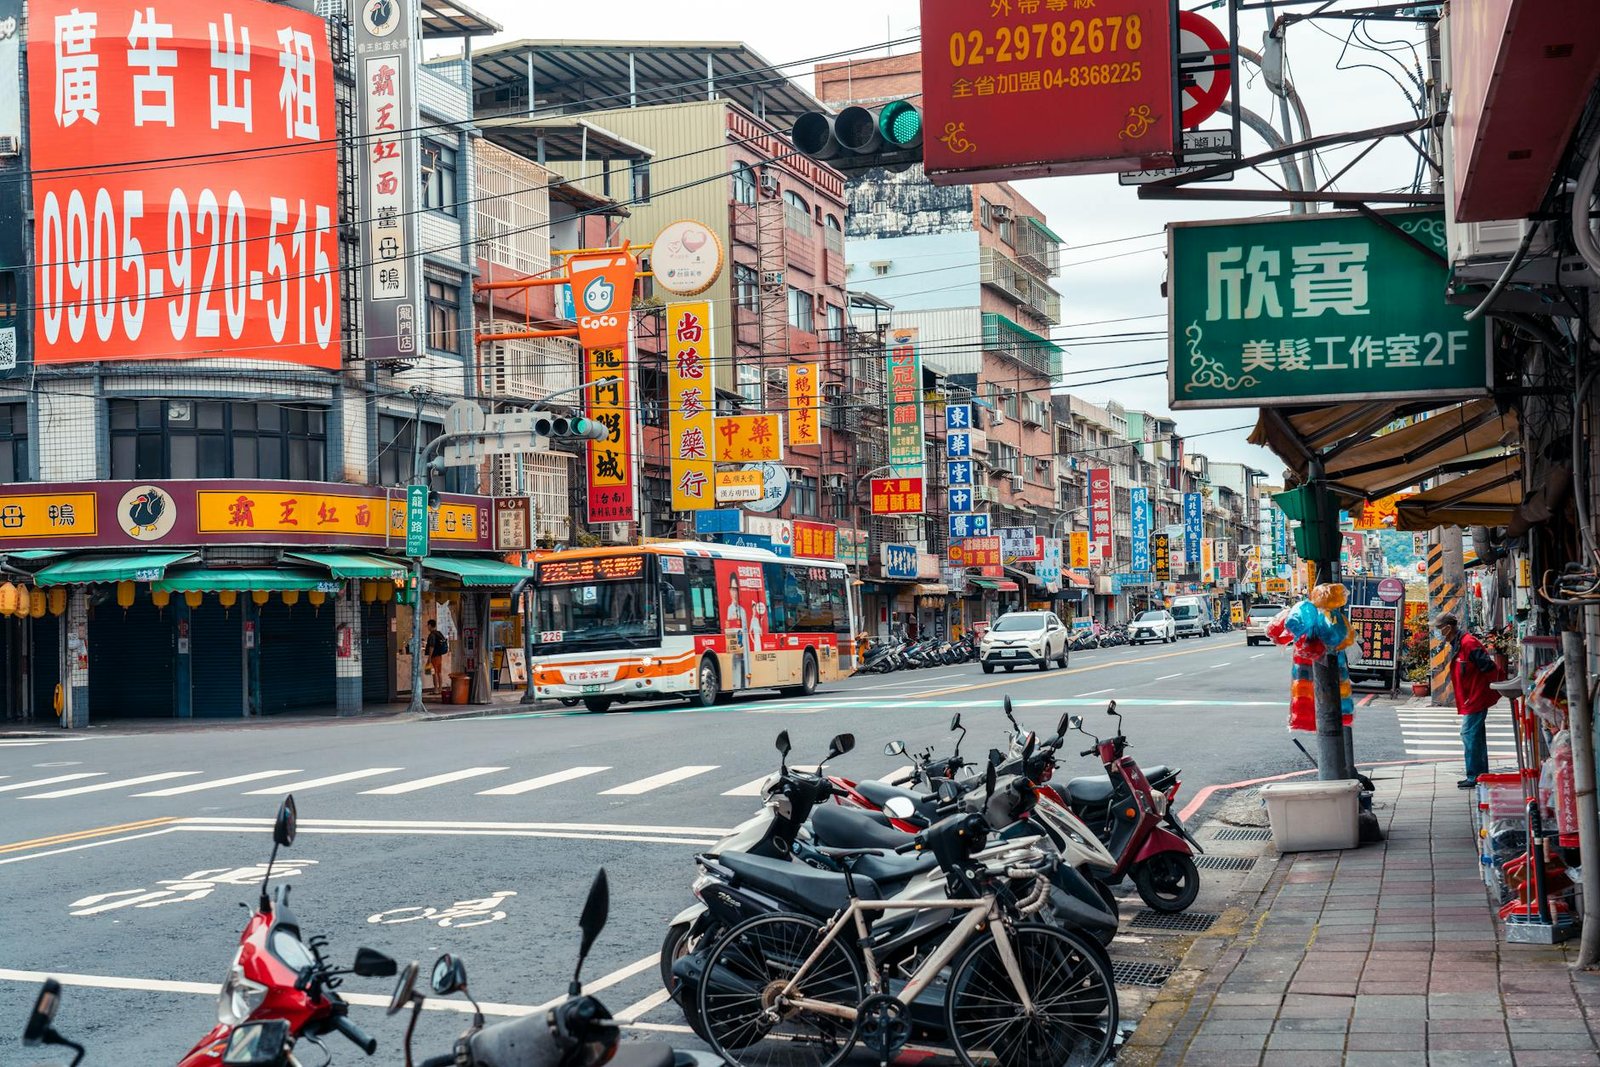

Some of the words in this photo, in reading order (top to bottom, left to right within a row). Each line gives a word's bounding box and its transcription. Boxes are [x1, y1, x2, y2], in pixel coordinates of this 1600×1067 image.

[950, 14, 1143, 67] 02-29782678
[54, 8, 321, 141] 廣告出租
[41, 187, 334, 350] 0905-920-515
[399, 306, 412, 350] 龍門店
[1241, 330, 1469, 372] 美髮工作室2F
[676, 311, 708, 499] 尚德蔘藥行
[795, 377, 812, 438] 鵝肉專家
[720, 417, 772, 446] 中藥
[722, 446, 772, 459] 大批發
[949, 407, 969, 536] 東華堂中醫
[411, 496, 423, 533] 龍門路
[873, 492, 922, 512] 鹽酥雞
[1188, 494, 1199, 518] 新北市
[408, 534, 424, 542] Long-
[543, 632, 561, 642] 226
